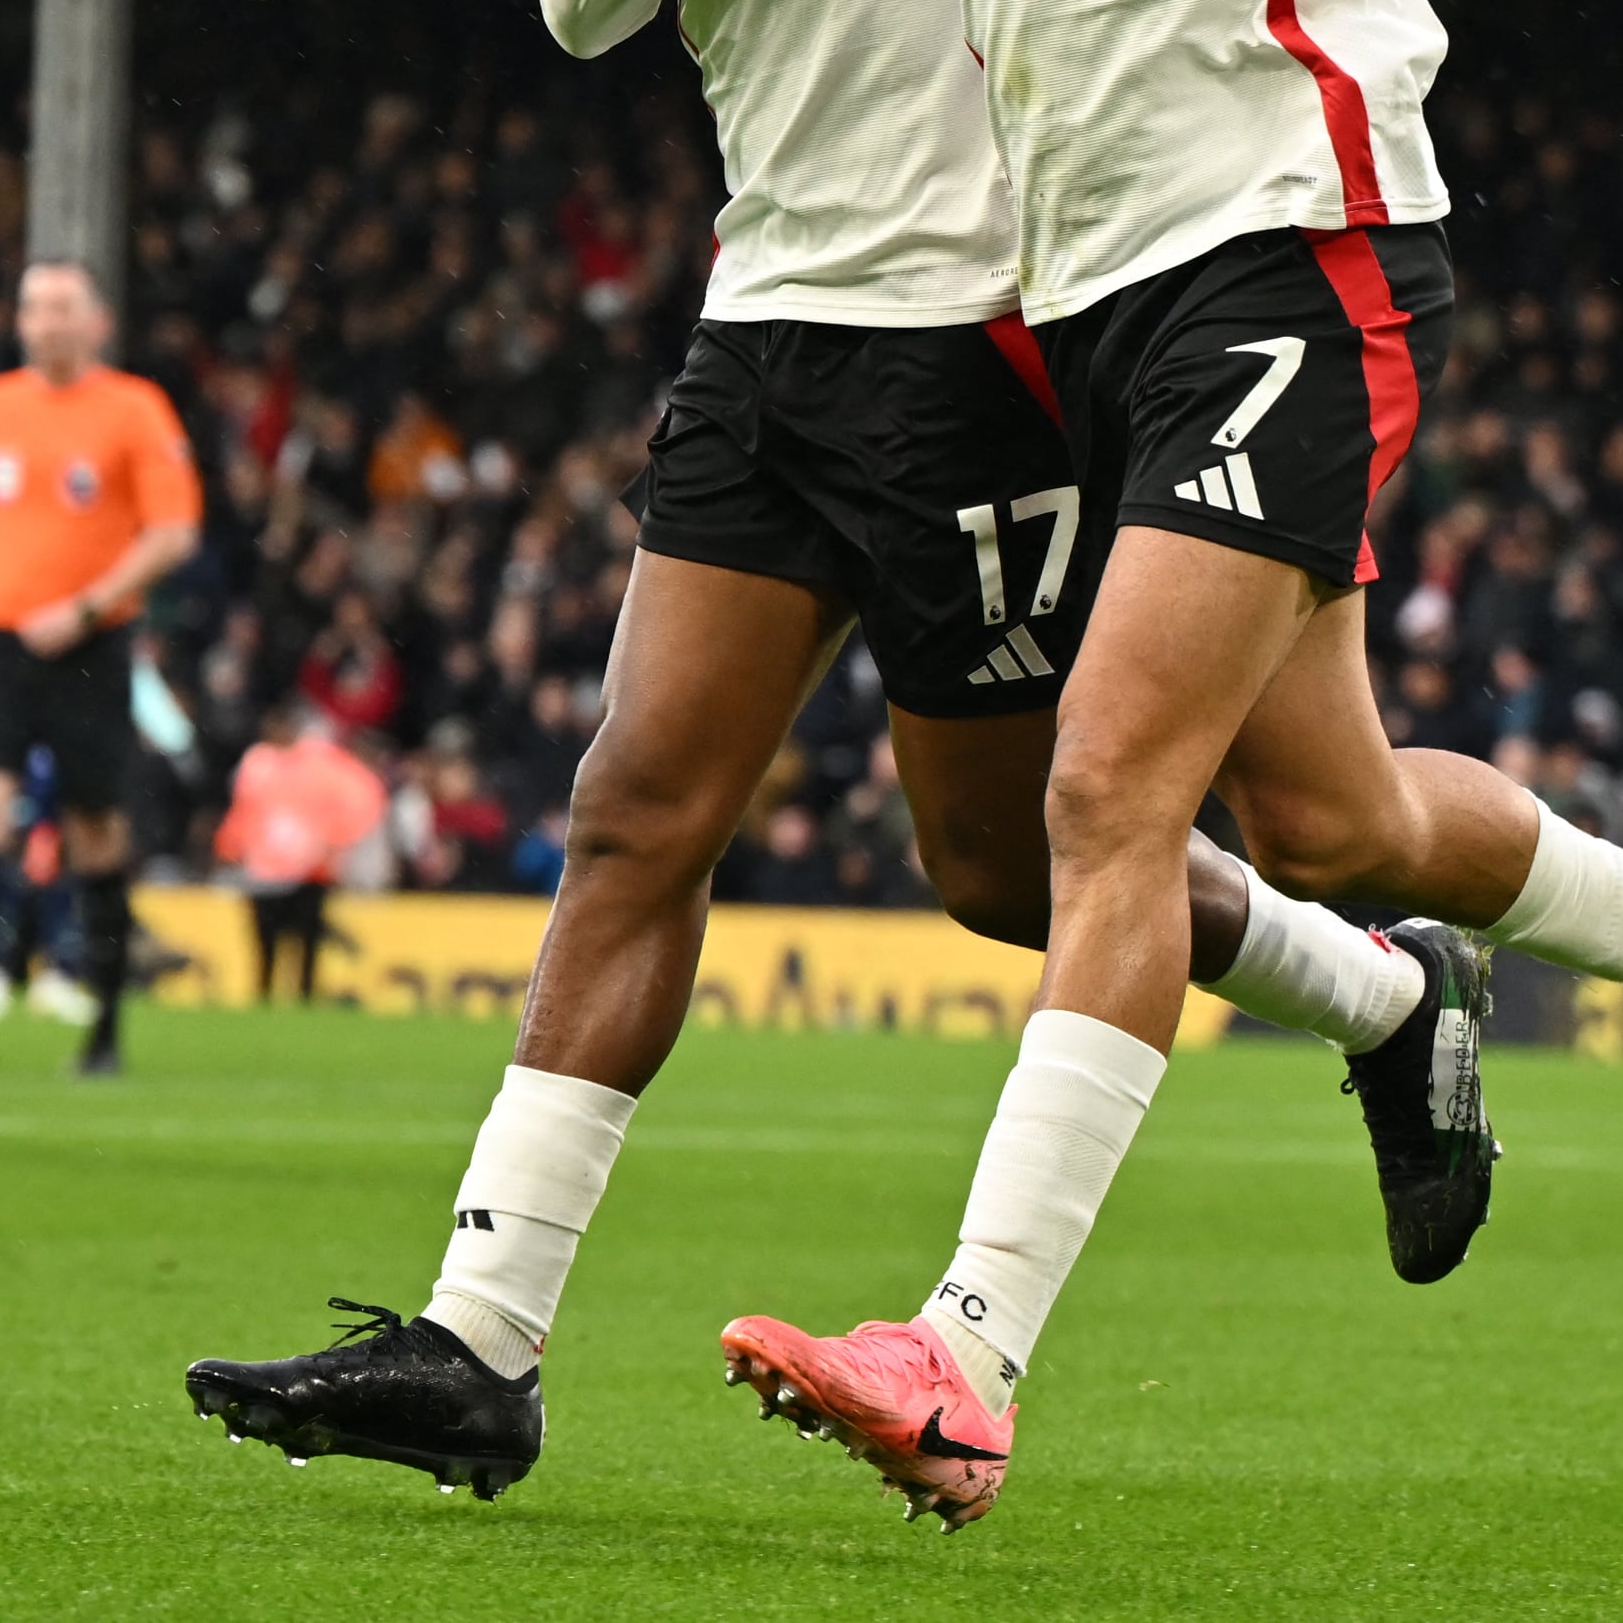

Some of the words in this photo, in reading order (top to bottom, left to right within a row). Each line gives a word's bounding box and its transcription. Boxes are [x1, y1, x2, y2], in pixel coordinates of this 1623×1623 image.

[1210, 335, 1307, 449] 7
[955, 484, 1080, 626] 17
[935, 1280, 988, 1322] FC
